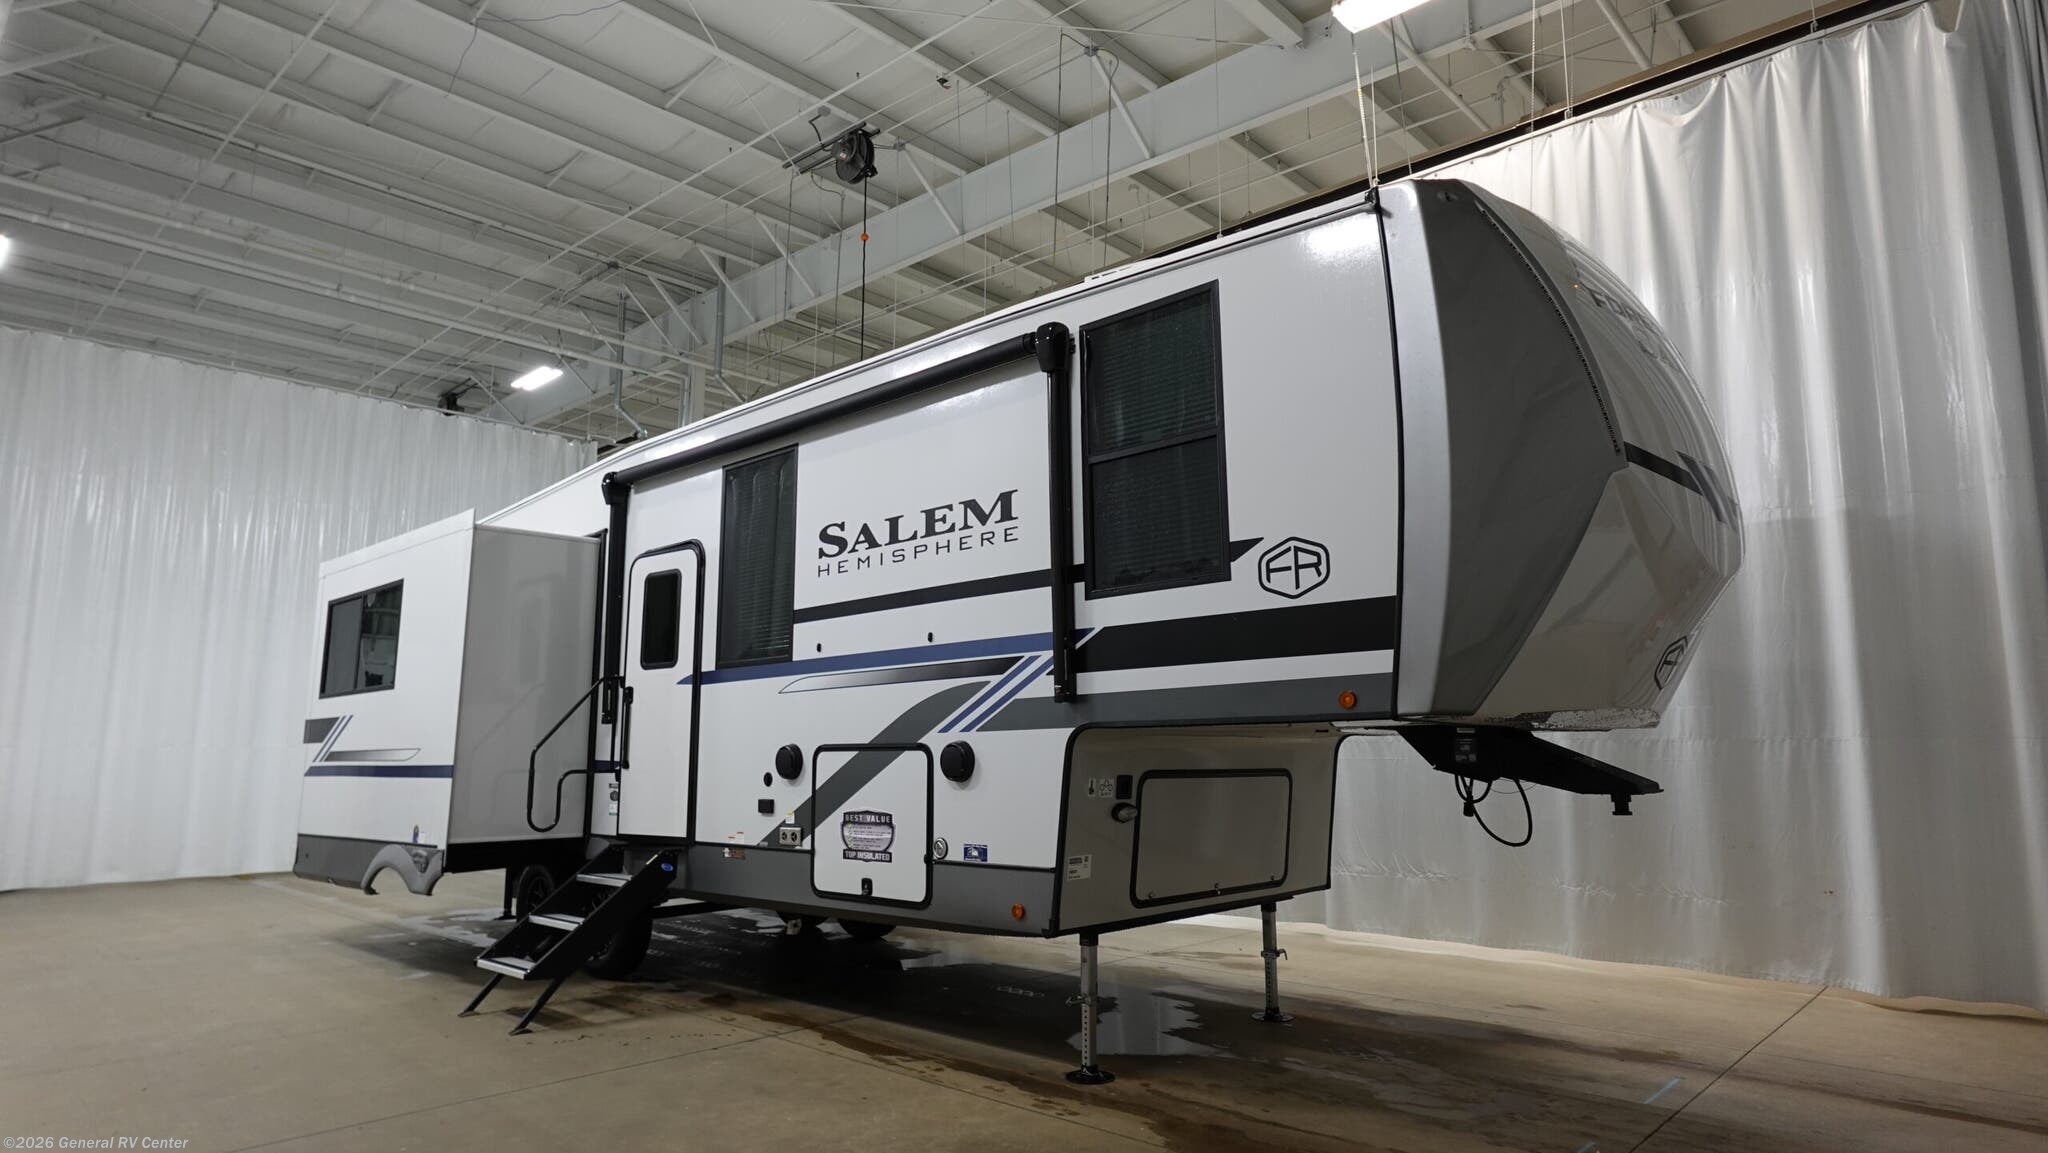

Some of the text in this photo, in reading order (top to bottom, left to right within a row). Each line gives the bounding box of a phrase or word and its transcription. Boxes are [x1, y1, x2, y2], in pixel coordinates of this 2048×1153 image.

[818, 489, 1018, 559] SALEM
[818, 526, 1019, 577] HEMISPHERE
[866, 815, 891, 823] VALUE
[857, 851, 890, 861] INSULATED
